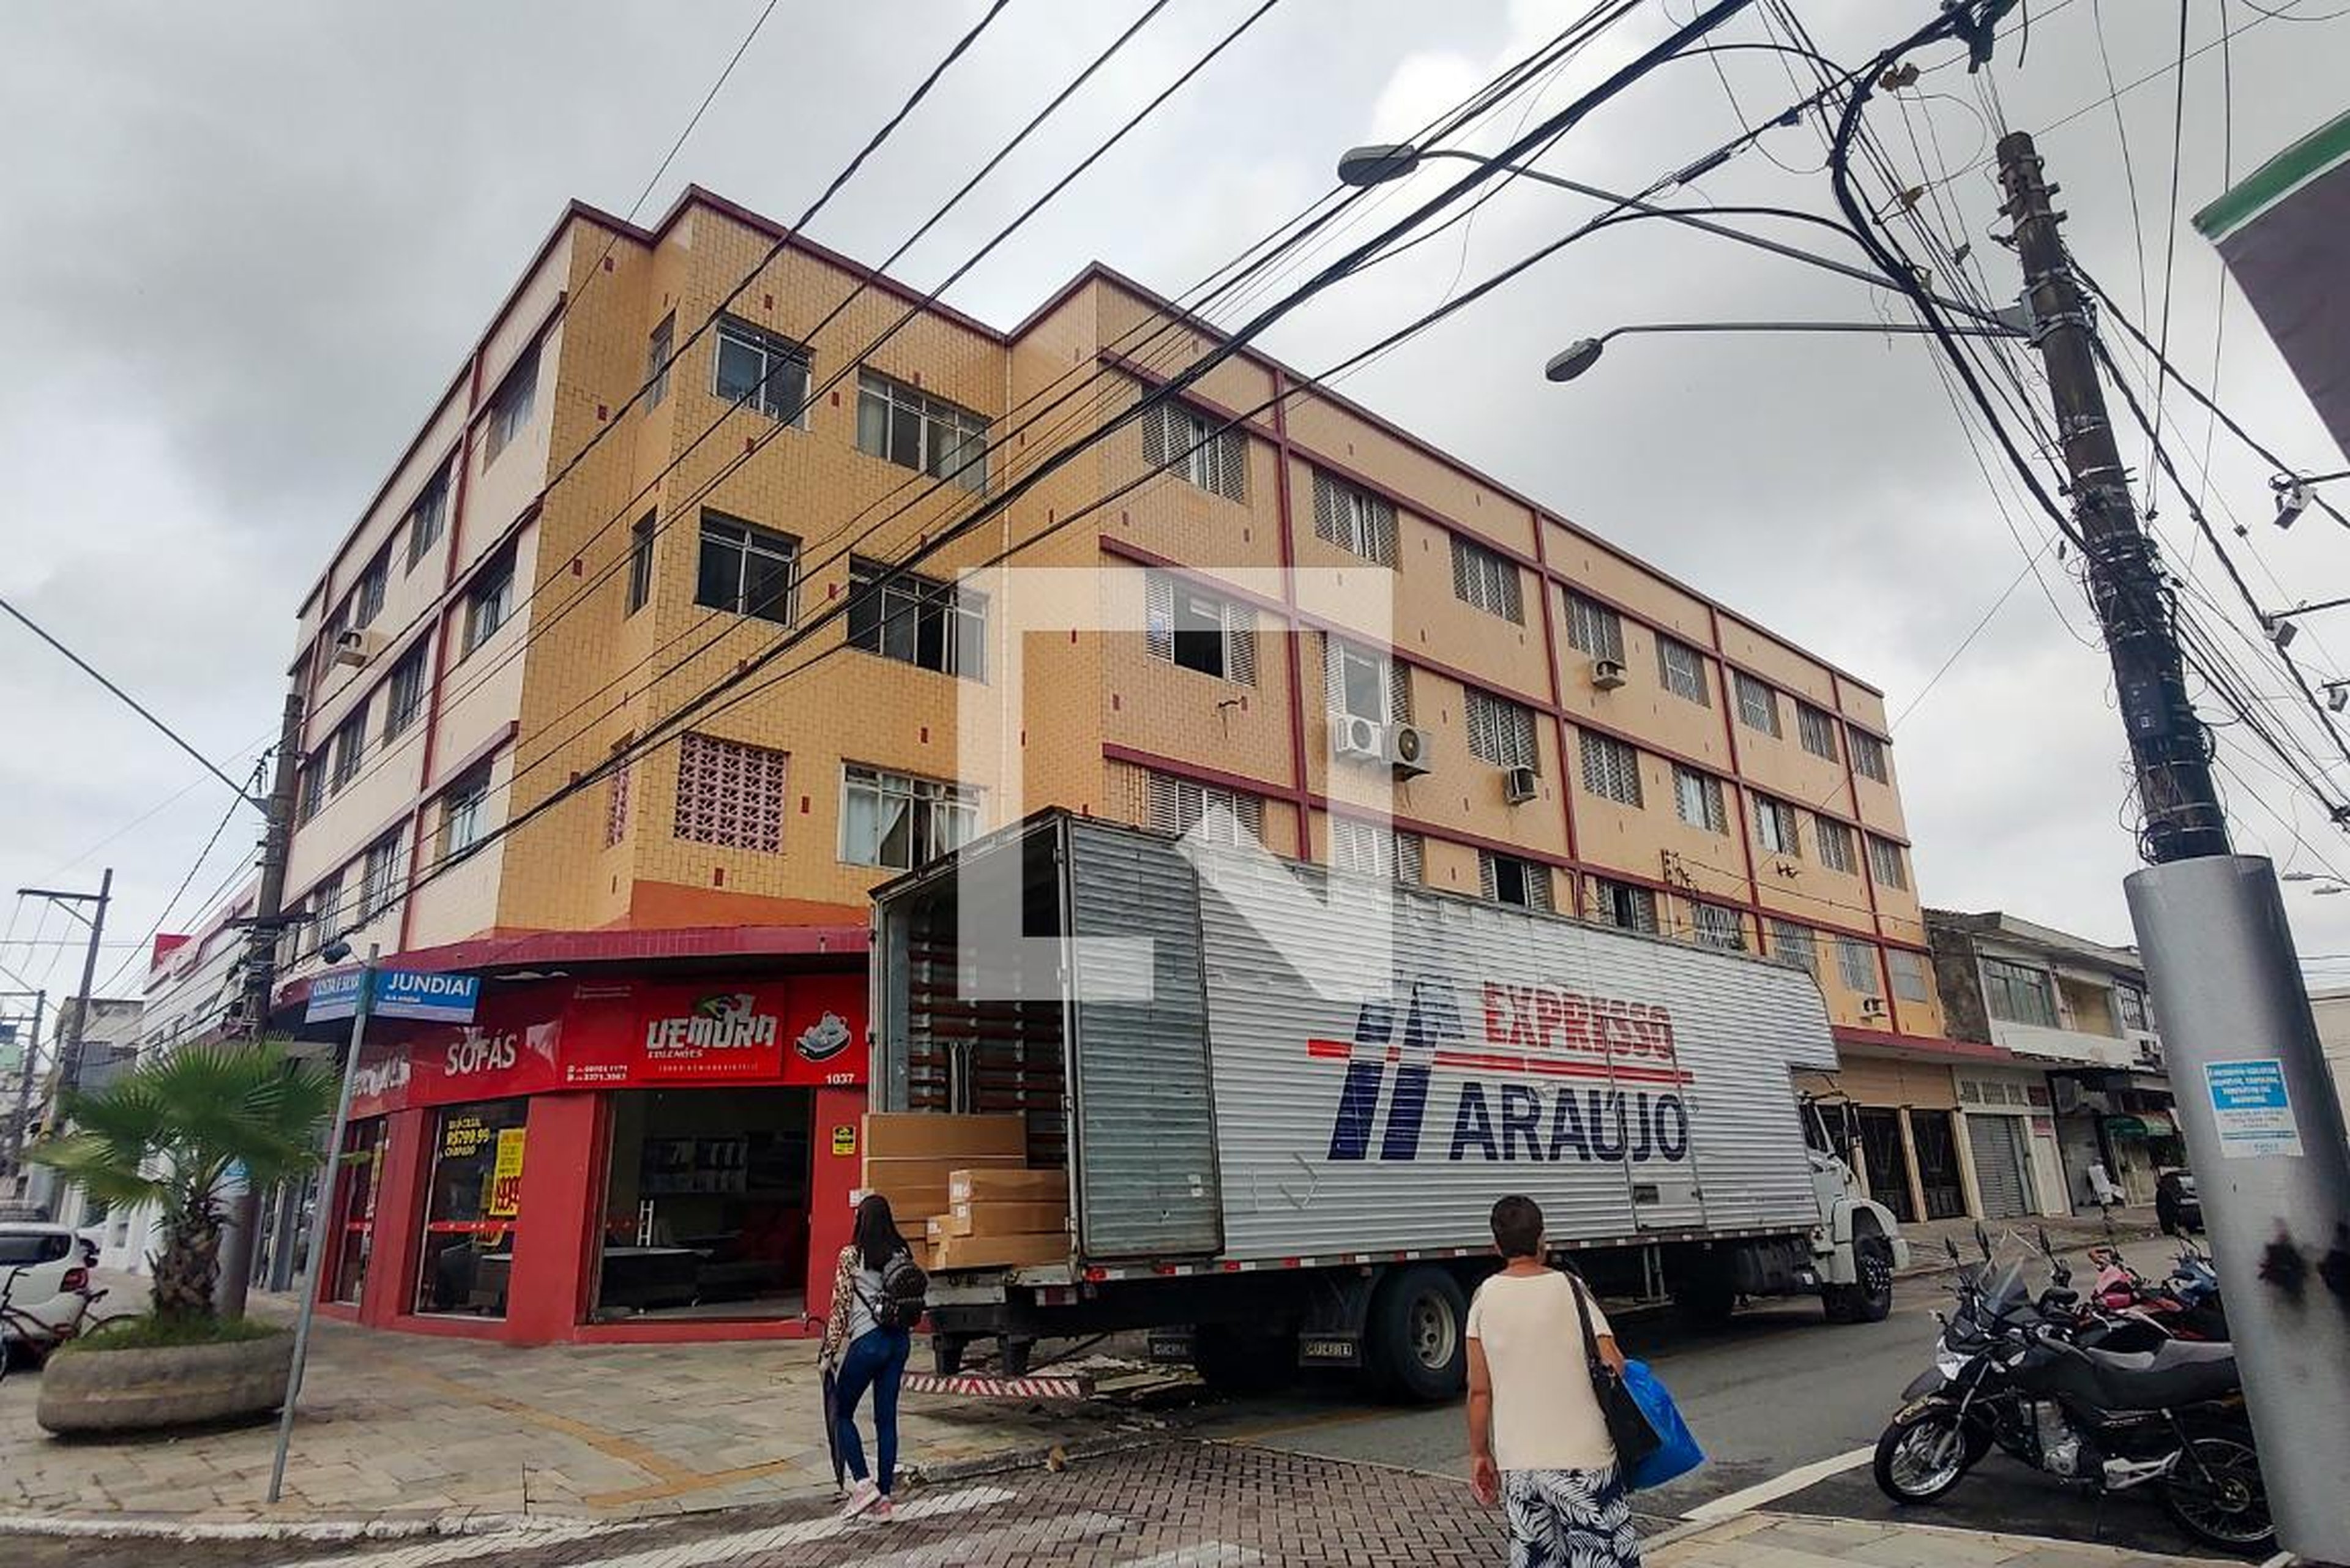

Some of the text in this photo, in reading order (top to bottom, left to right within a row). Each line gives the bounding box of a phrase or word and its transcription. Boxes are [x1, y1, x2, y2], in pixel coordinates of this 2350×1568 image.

[1482, 980, 1673, 1060] EXPRESSO
[444, 1029, 518, 1077] SOFÁS
[826, 1073, 854, 1085] 1037
[1448, 1081, 1688, 1162] ARAÚJO
